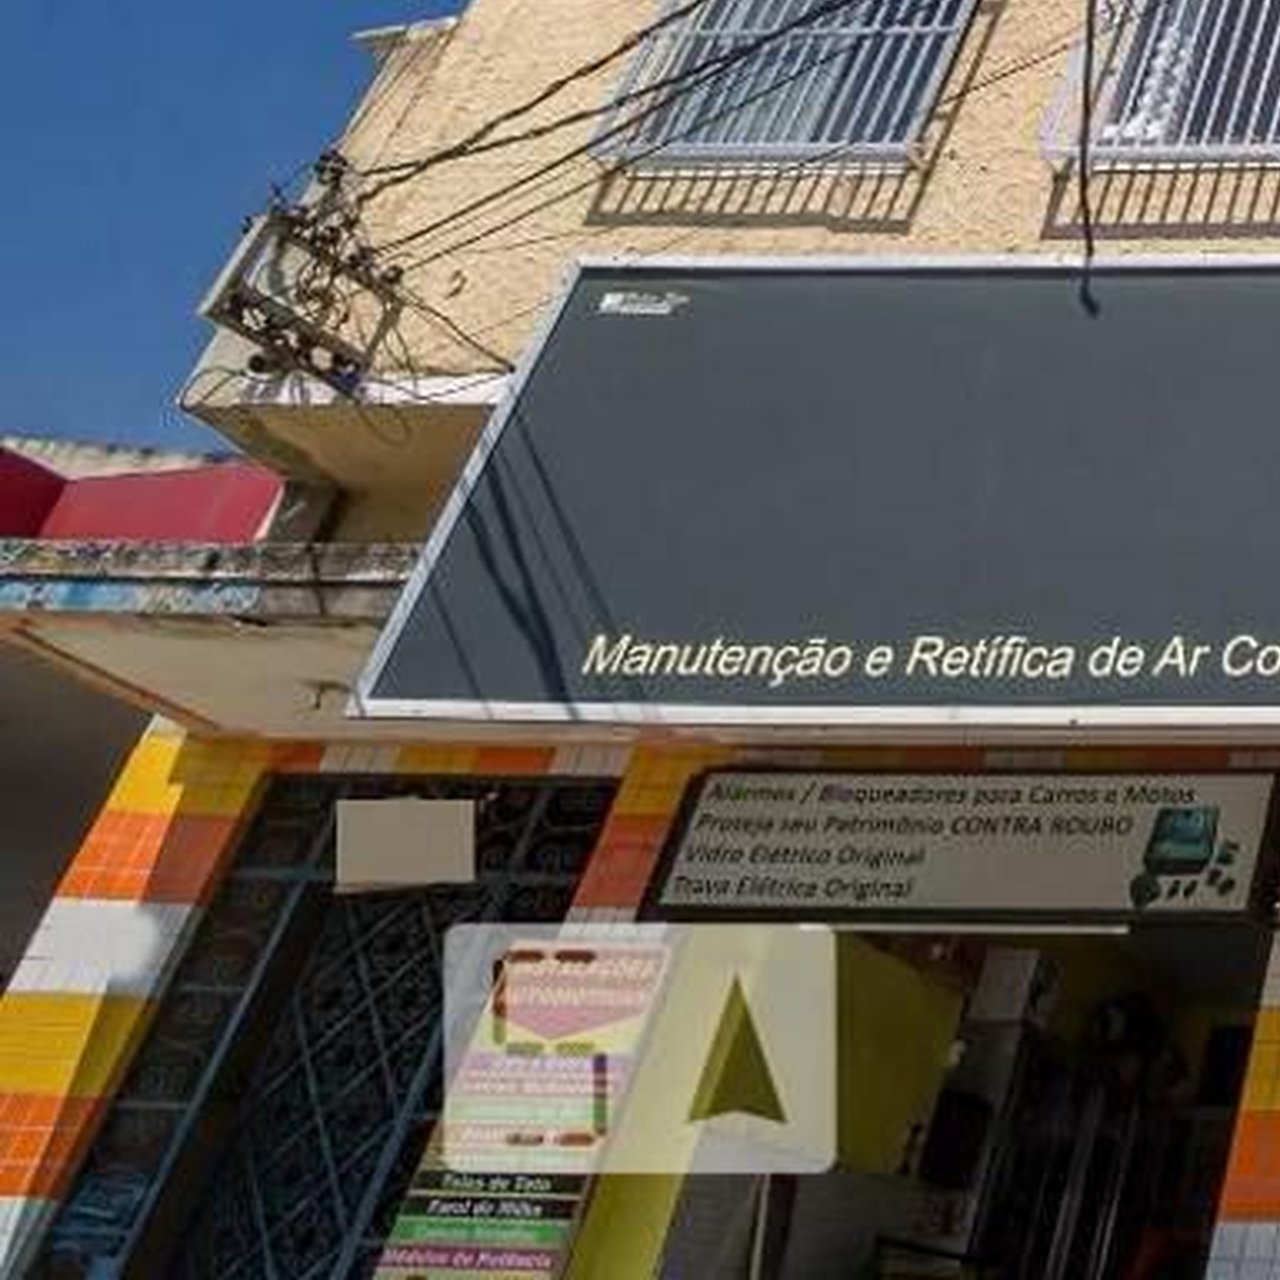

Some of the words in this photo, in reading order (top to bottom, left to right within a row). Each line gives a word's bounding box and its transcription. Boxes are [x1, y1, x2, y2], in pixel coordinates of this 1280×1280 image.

[582, 634, 852, 688] Manutenção
[864, 645, 894, 678] e
[905, 634, 1074, 679] Retífica
[1088, 635, 1141, 677] de
[1153, 635, 1210, 677] Ar
[972, 788, 1022, 806] para
[1028, 784, 1098, 803] Carros
[1122, 784, 1195, 804] Motos
[694, 813, 775, 836] Proteja
[779, 818, 818, 833] seu
[951, 816, 1043, 835] CONTRA
[1050, 816, 1134, 835] ROUBO
[685, 844, 745, 864] Vidro
[836, 844, 926, 869] Original
[674, 876, 731, 896] Trava
[823, 876, 914, 900] Original
